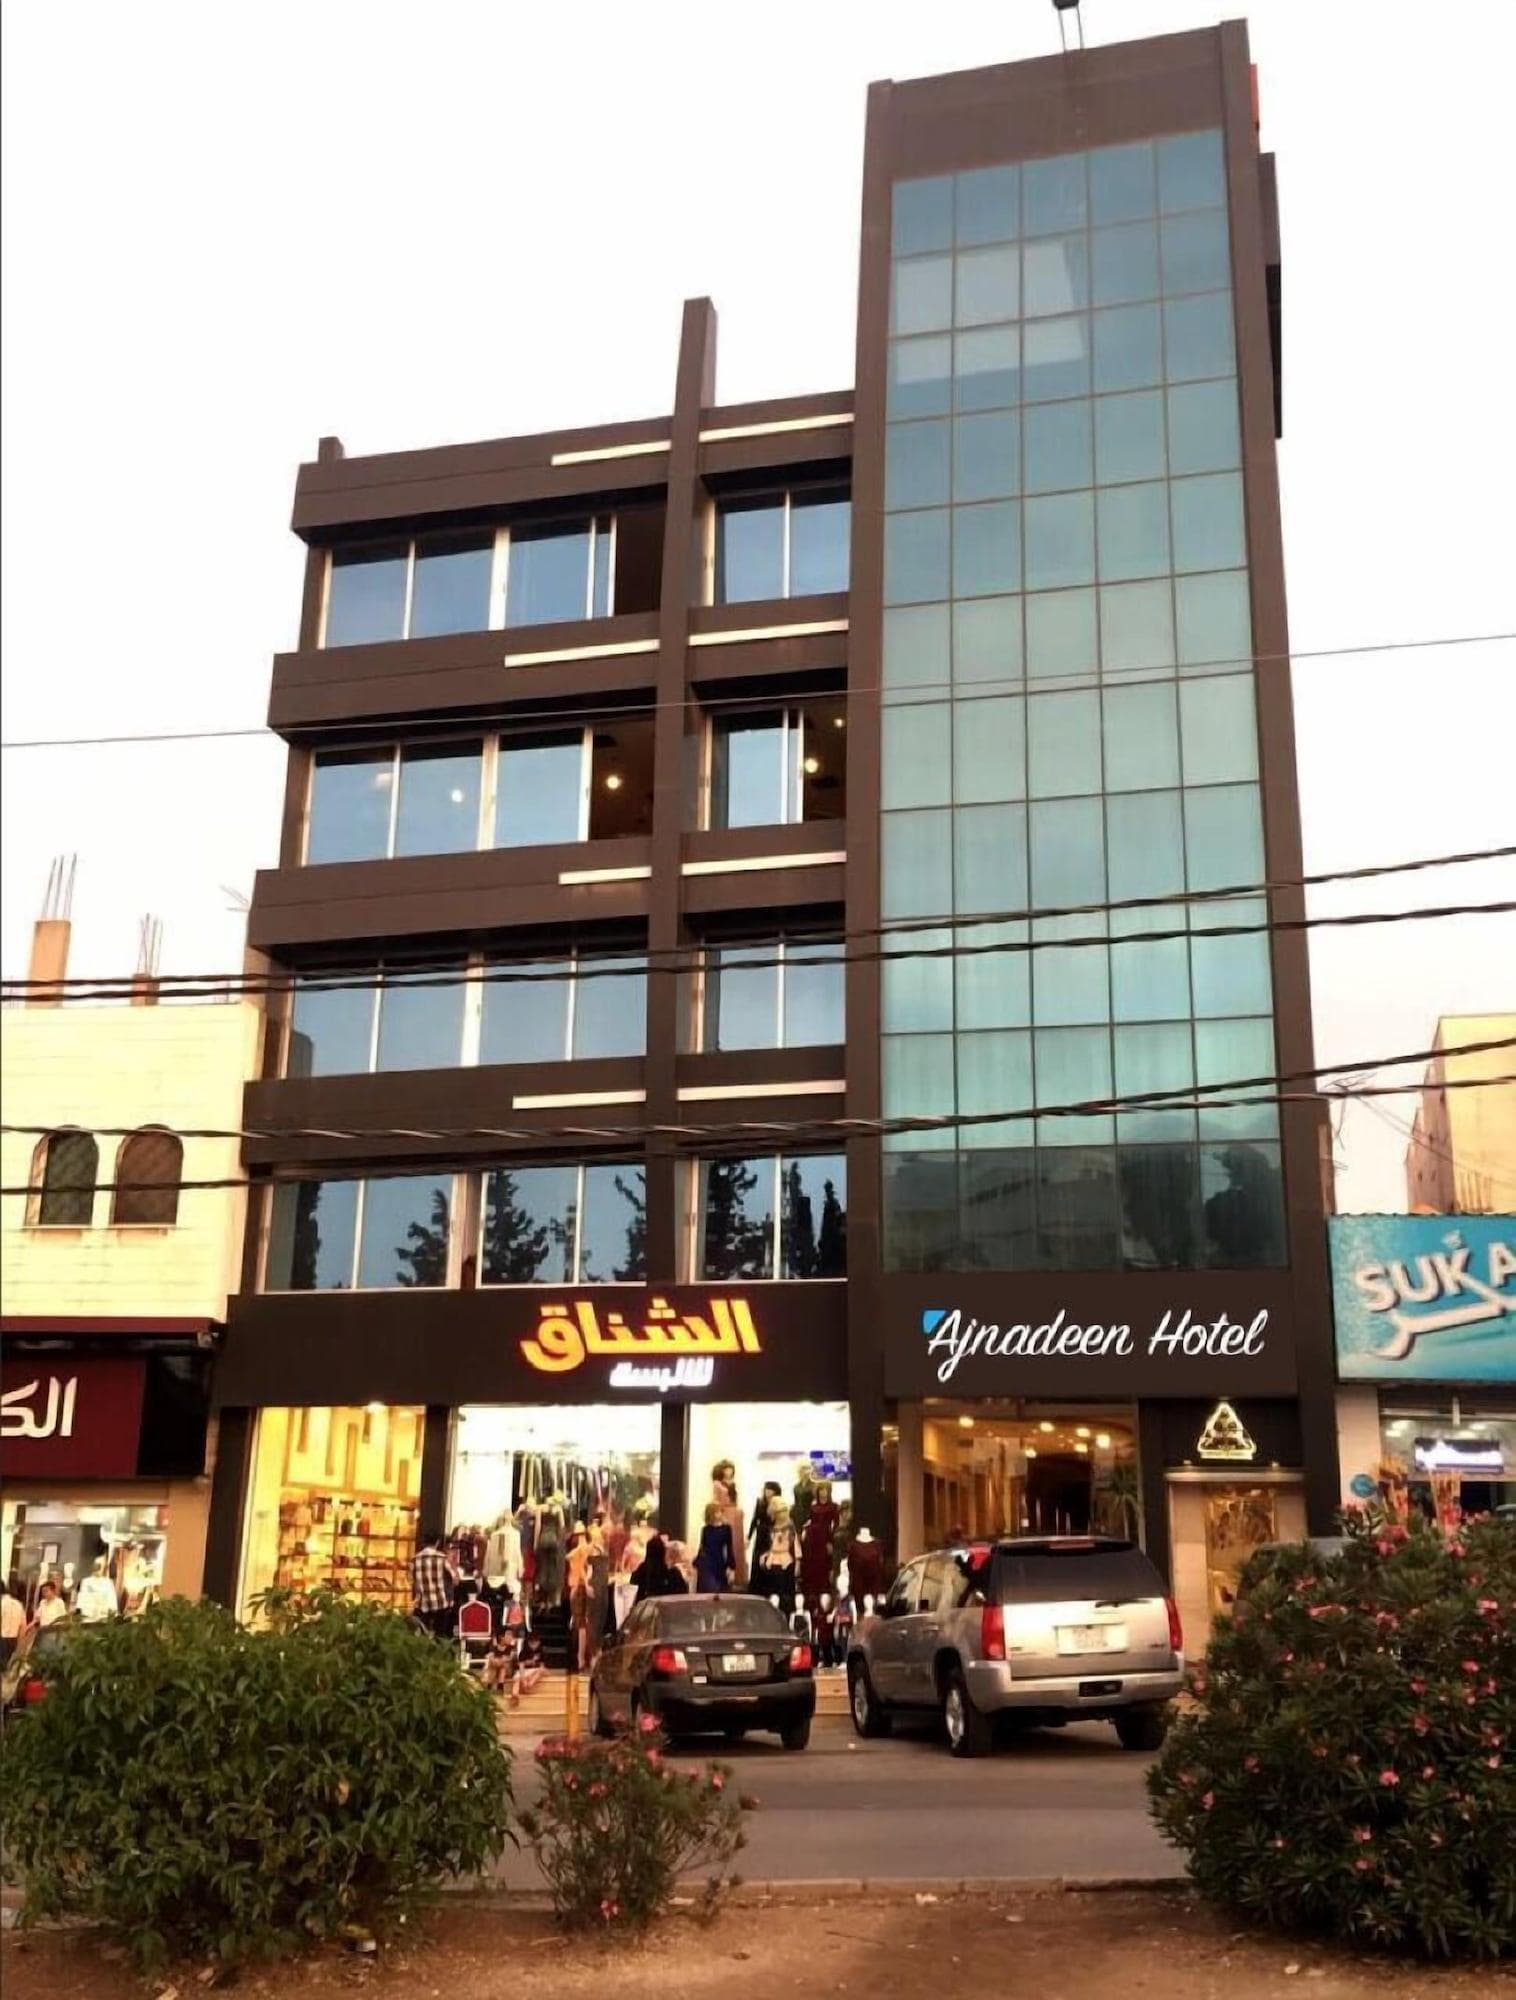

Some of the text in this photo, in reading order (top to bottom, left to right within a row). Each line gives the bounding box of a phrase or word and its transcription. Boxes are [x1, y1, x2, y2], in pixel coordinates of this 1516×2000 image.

[519, 1297, 763, 1373] الشناق
[927, 1308, 1269, 1383] Ajnadeen Hotel
